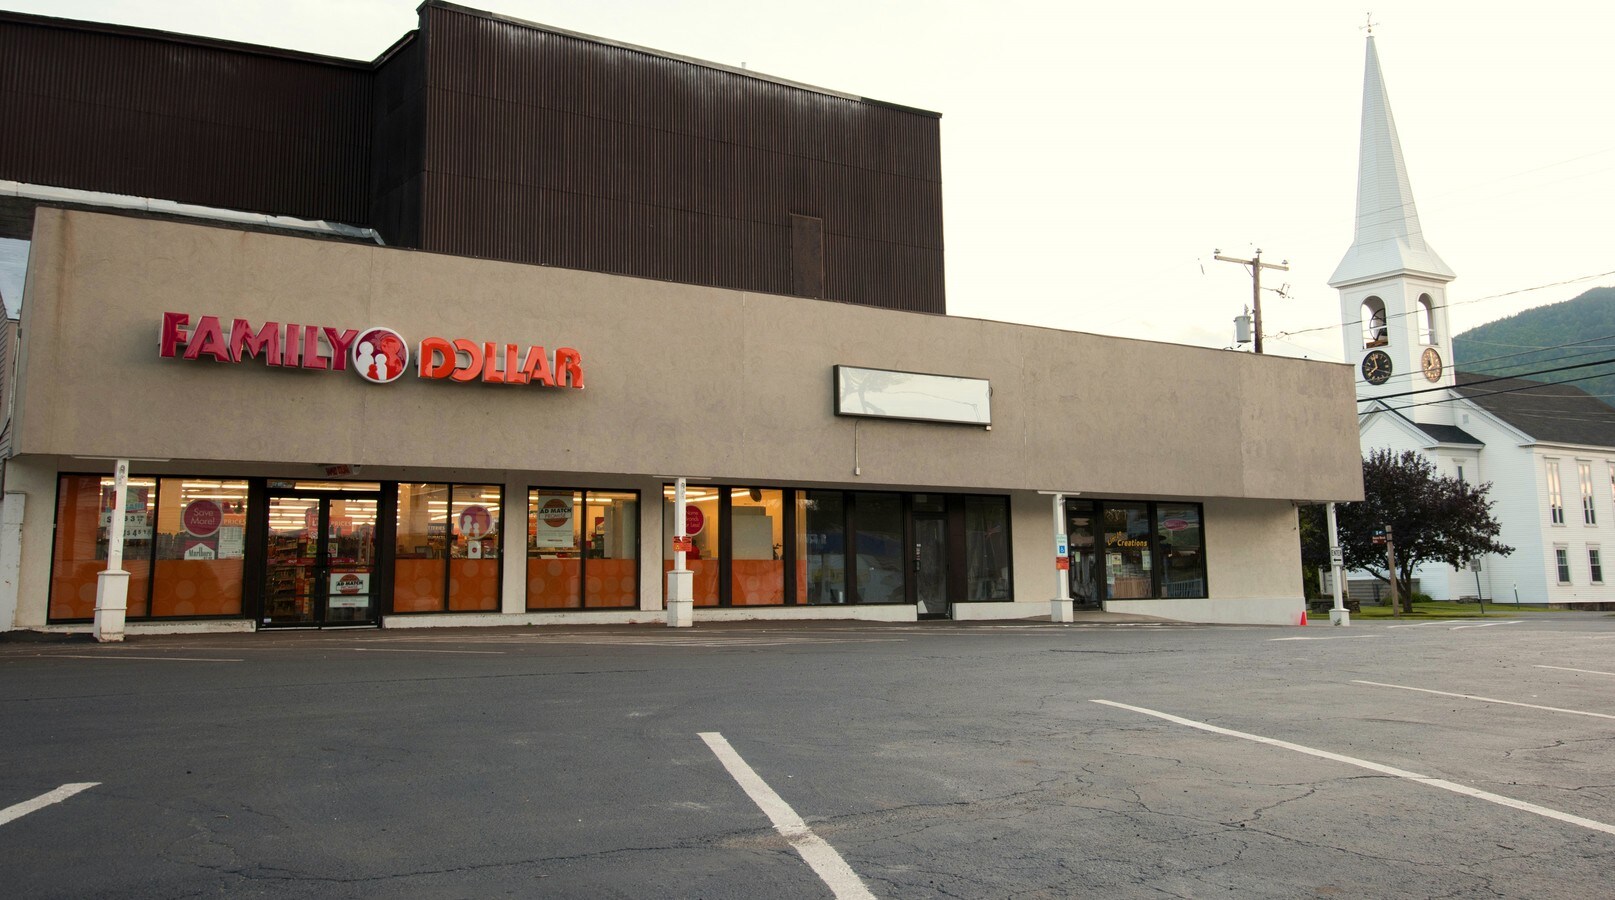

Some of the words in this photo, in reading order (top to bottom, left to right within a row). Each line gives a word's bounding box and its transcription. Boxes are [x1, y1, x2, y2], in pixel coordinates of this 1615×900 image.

[158, 311, 360, 372] FAMILY
[417, 336, 585, 390] DOLLAR
[193, 507, 214, 517] Save
[190, 517, 216, 525] More!
[1117, 539, 1148, 547] Creations
